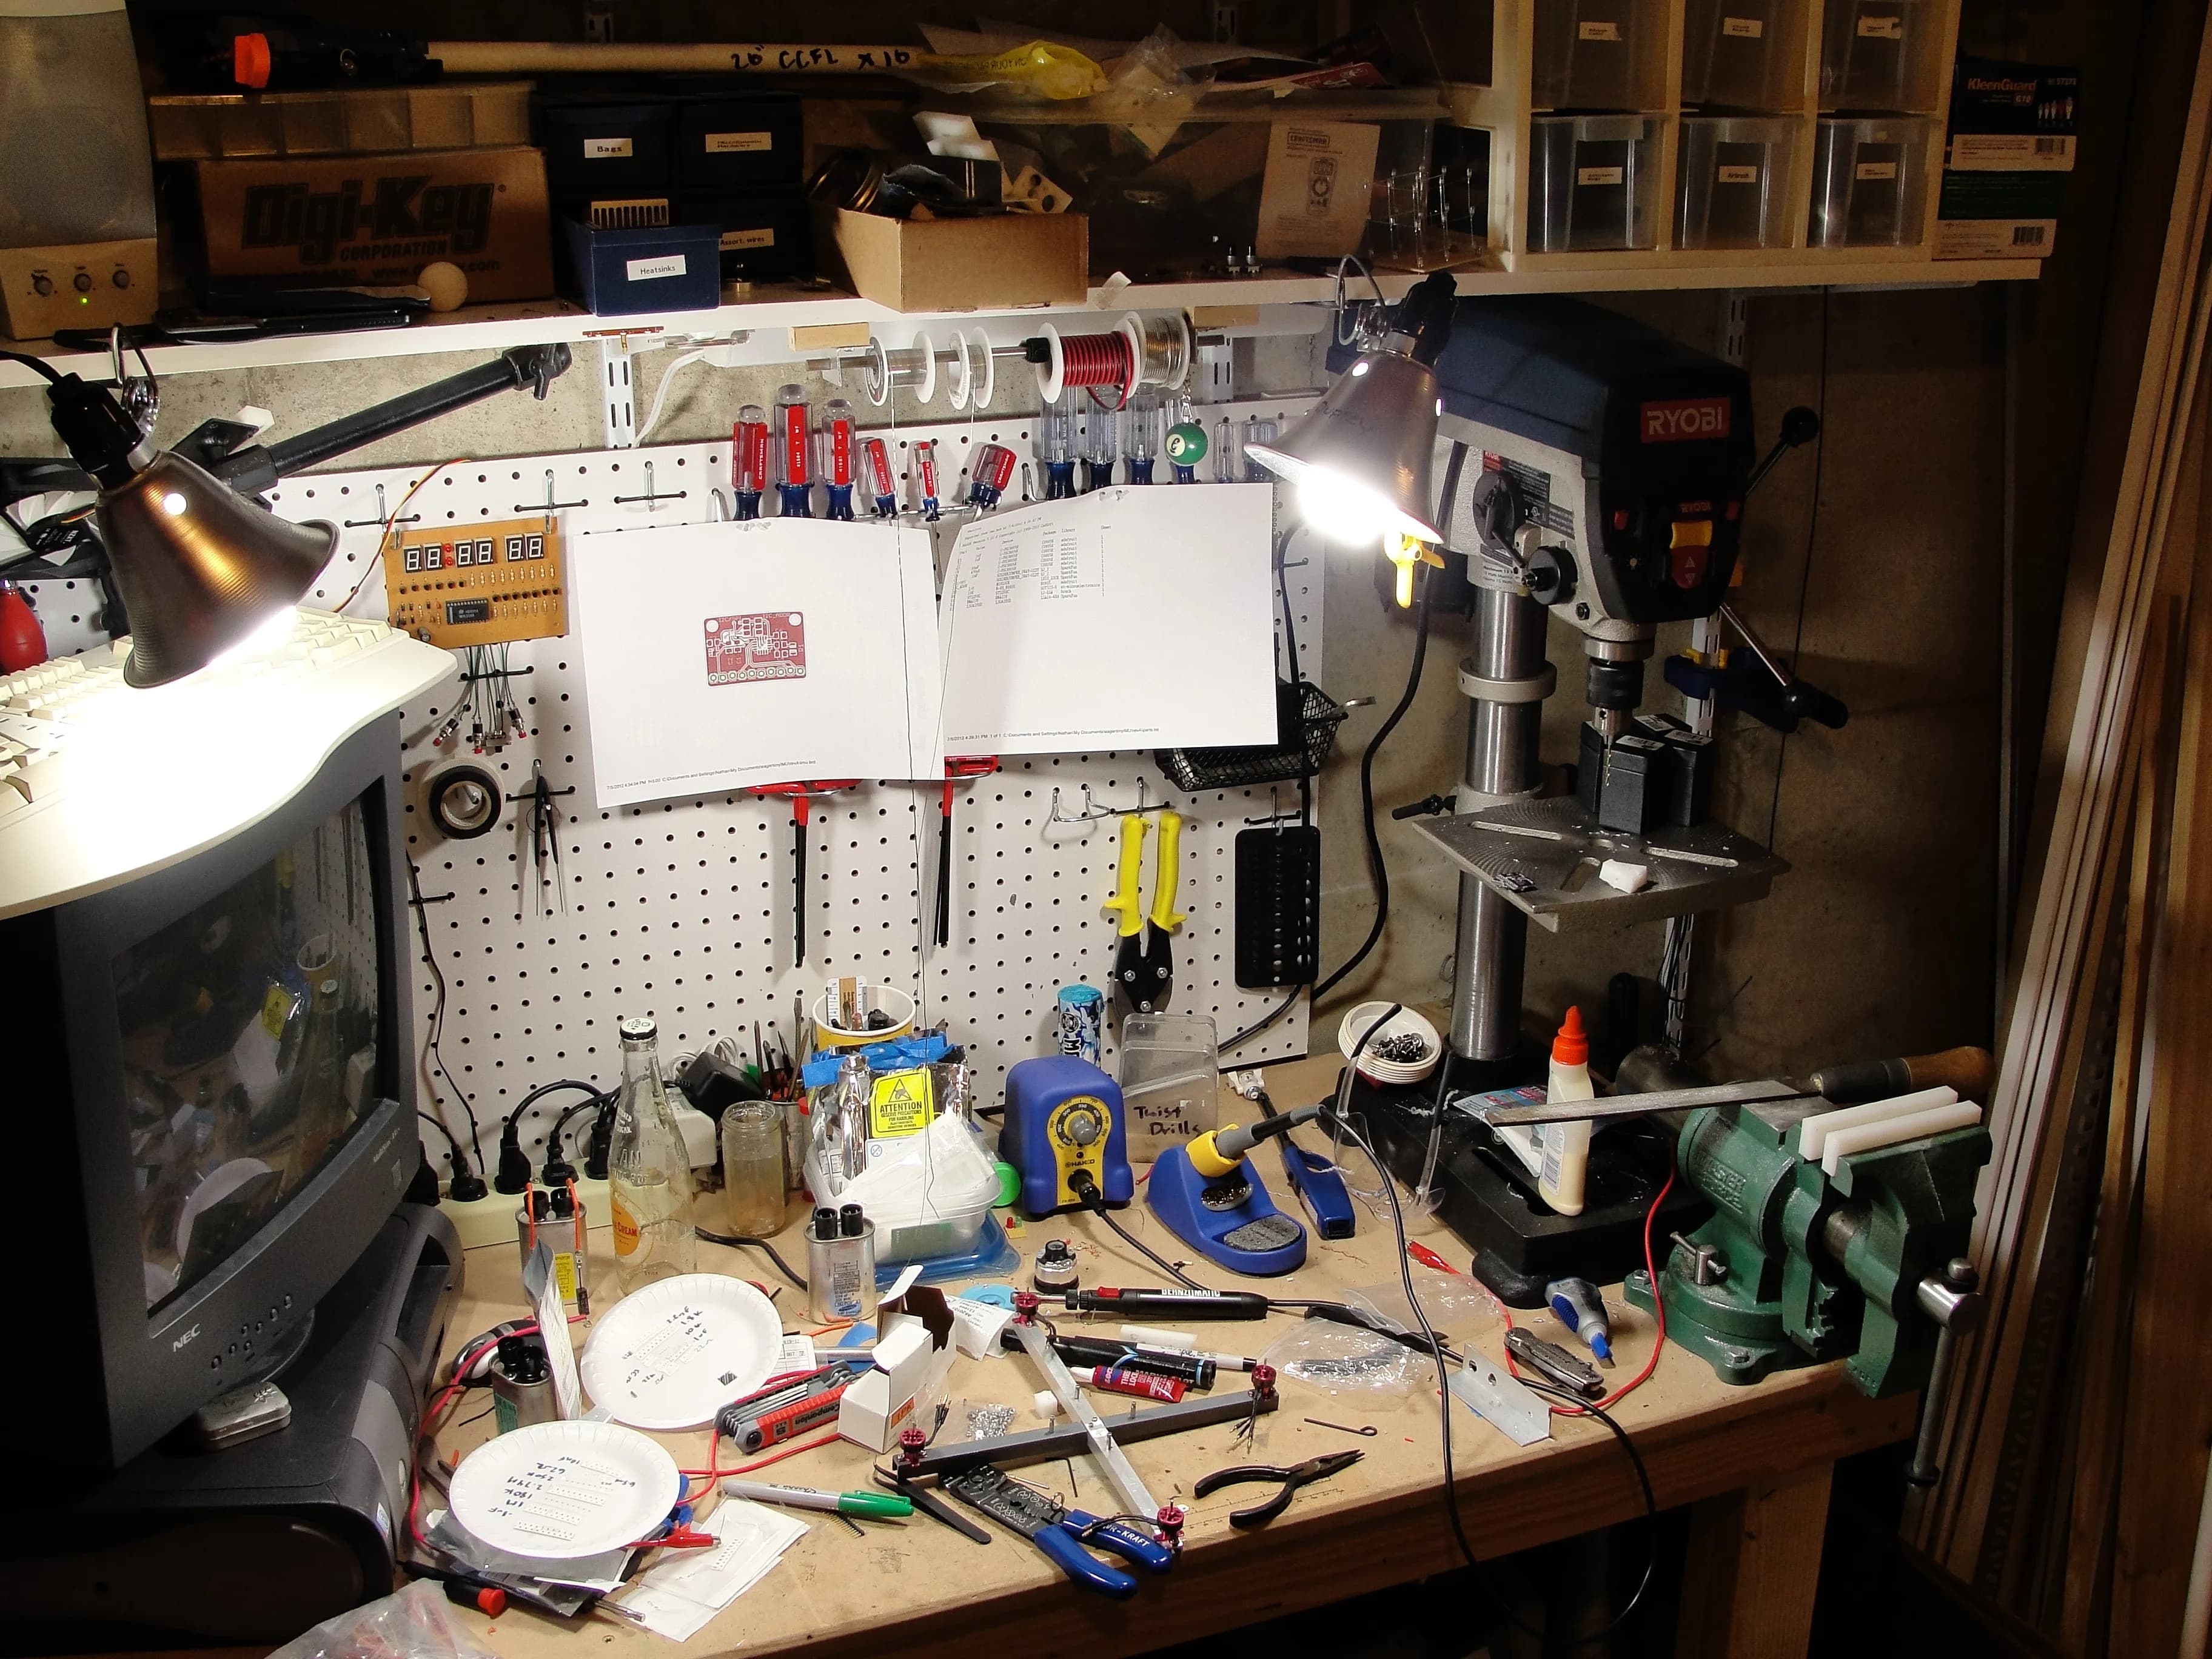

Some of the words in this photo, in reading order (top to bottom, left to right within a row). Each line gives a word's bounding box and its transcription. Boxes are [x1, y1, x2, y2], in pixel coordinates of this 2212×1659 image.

[779, 49, 839, 70] CCFL
[597, 145, 623, 154] Bags
[243, 175, 494, 264] Digi-Key
[340, 241, 447, 262] CORPORATION
[640, 266, 676, 276] Heatsinks
[1646, 407, 1723, 435] RYOBI
[1679, 501, 1712, 514] RYOBI
[880, 1101, 922, 1113] ATTENTION
[1133, 1105, 1181, 1119] Twist
[1150, 1121, 1203, 1138] Drills
[173, 1322, 201, 1353] NEC
[794, 1403, 840, 1426] Companion
[1092, 1519, 1150, 1547] WR-KRAFT
